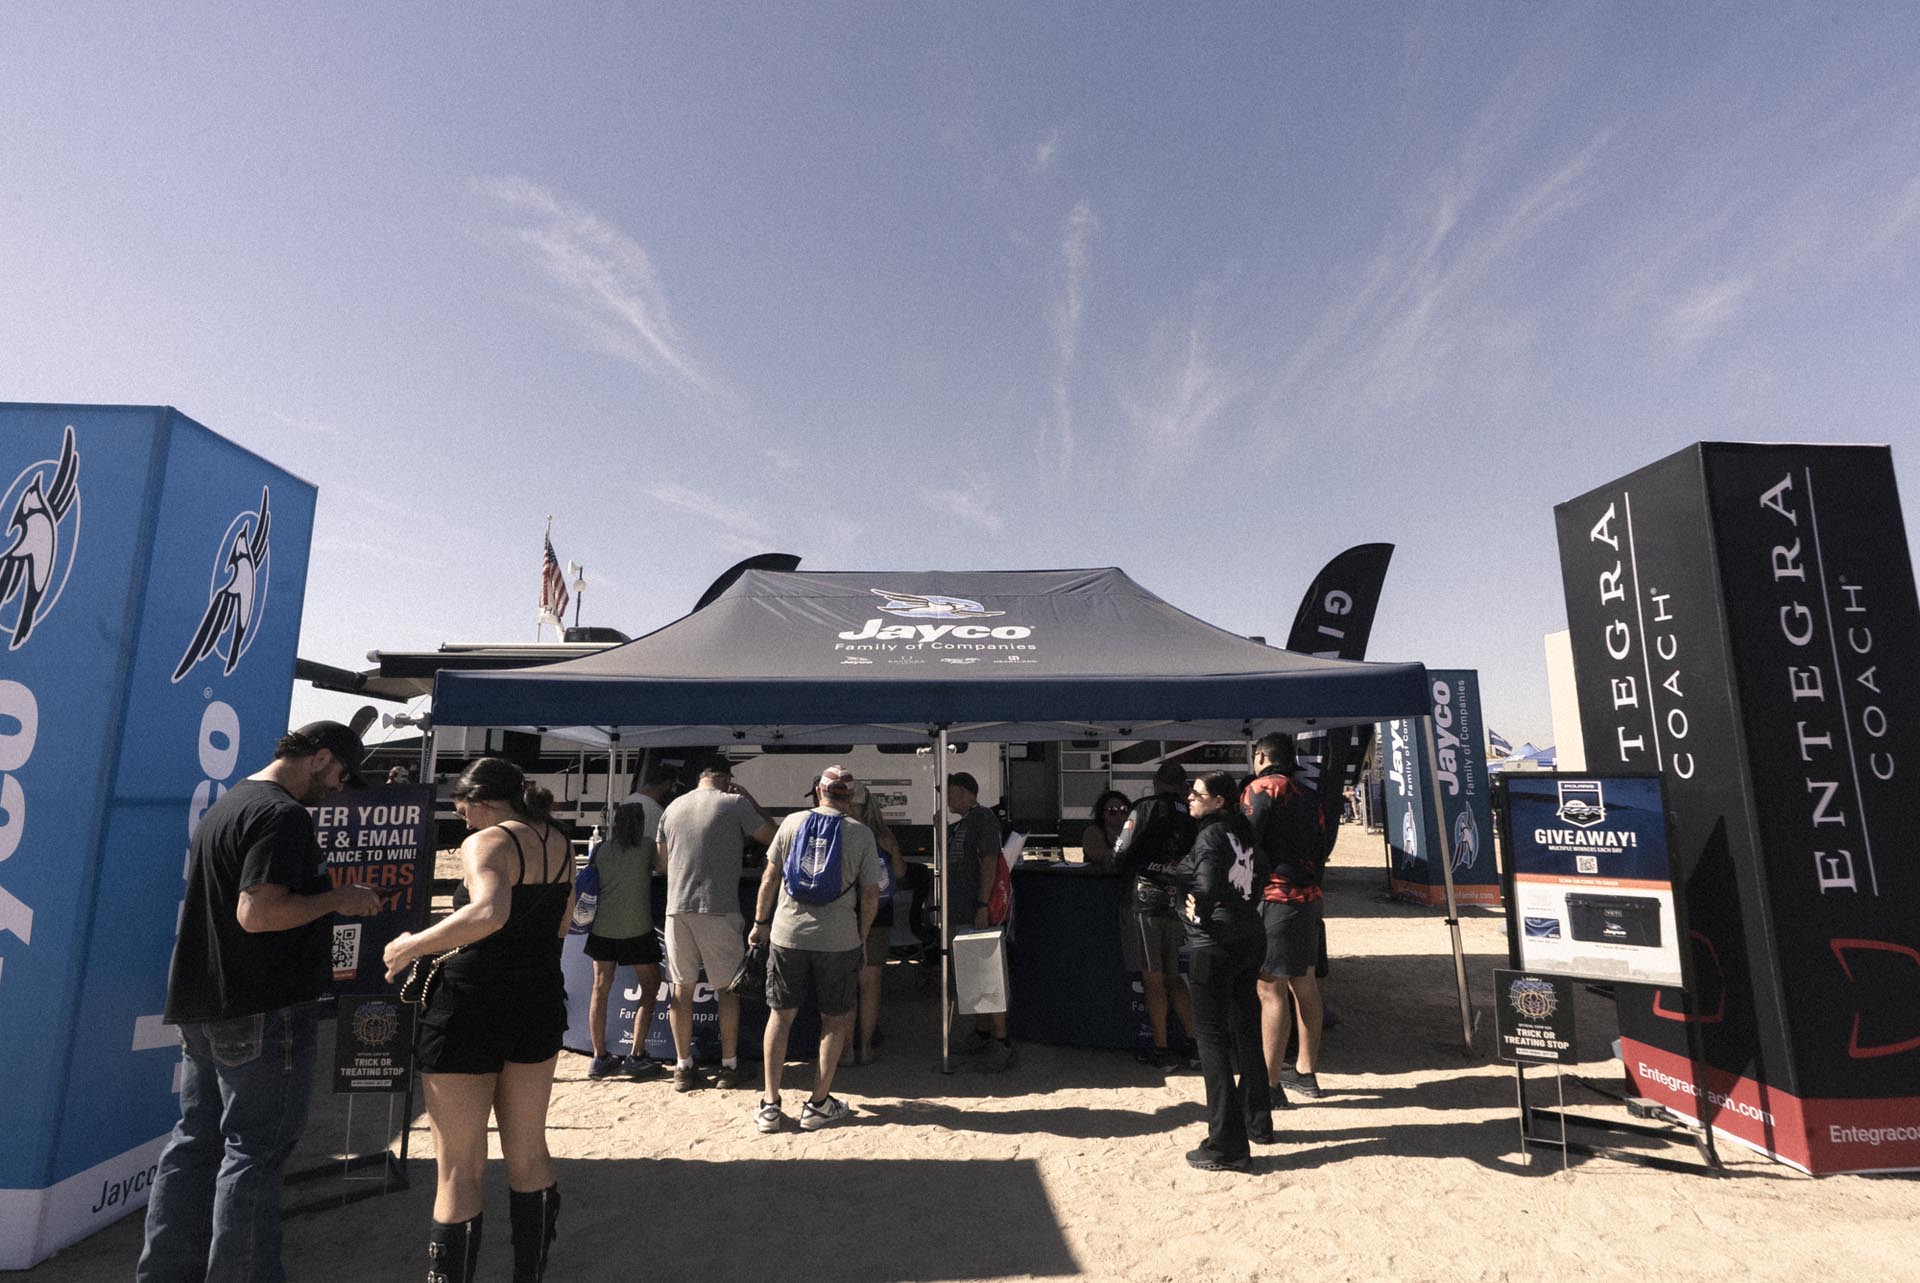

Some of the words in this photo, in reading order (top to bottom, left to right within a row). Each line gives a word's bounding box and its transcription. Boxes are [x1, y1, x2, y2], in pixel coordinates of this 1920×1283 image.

[838, 618, 1031, 643] Jayco
[1590, 502, 1645, 762] TEGRA
[835, 643, 897, 652] Family
[905, 642, 924, 650] of
[931, 642, 1037, 651] Companies
[1654, 593, 1695, 779] COACH
[1759, 472, 1859, 895] ENTEGRA
[1842, 584, 1895, 780] COACH
[1457, 680, 1469, 741] Companies
[1432, 680, 1460, 796] Jayco
[1402, 746, 1410, 757] of
[1462, 743, 1471, 756] of
[1403, 760, 1414, 797] Family
[1464, 759, 1475, 796] Family
[358, 805, 420, 826] YOUR
[335, 830, 350, 848] &
[357, 829, 417, 847] EMAIL
[1535, 829, 1637, 847] GIVEAWAY!
[326, 851, 362, 863] ANCE
[367, 850, 383, 861] TO
[387, 849, 416, 861] WIN!
[1504, 1035, 1546, 1047] TREATING
[1547, 1041, 1569, 1050] STOP
[1516, 1028, 1542, 1038] TRICK
[1543, 1031, 1555, 1039] OR
[340, 1067, 381, 1076] TREATING
[383, 1067, 404, 1076] STOP
[354, 1058, 378, 1066] TRICK
[380, 1058, 392, 1066] OR
[1638, 1061, 1775, 1127] Entegracach.com
